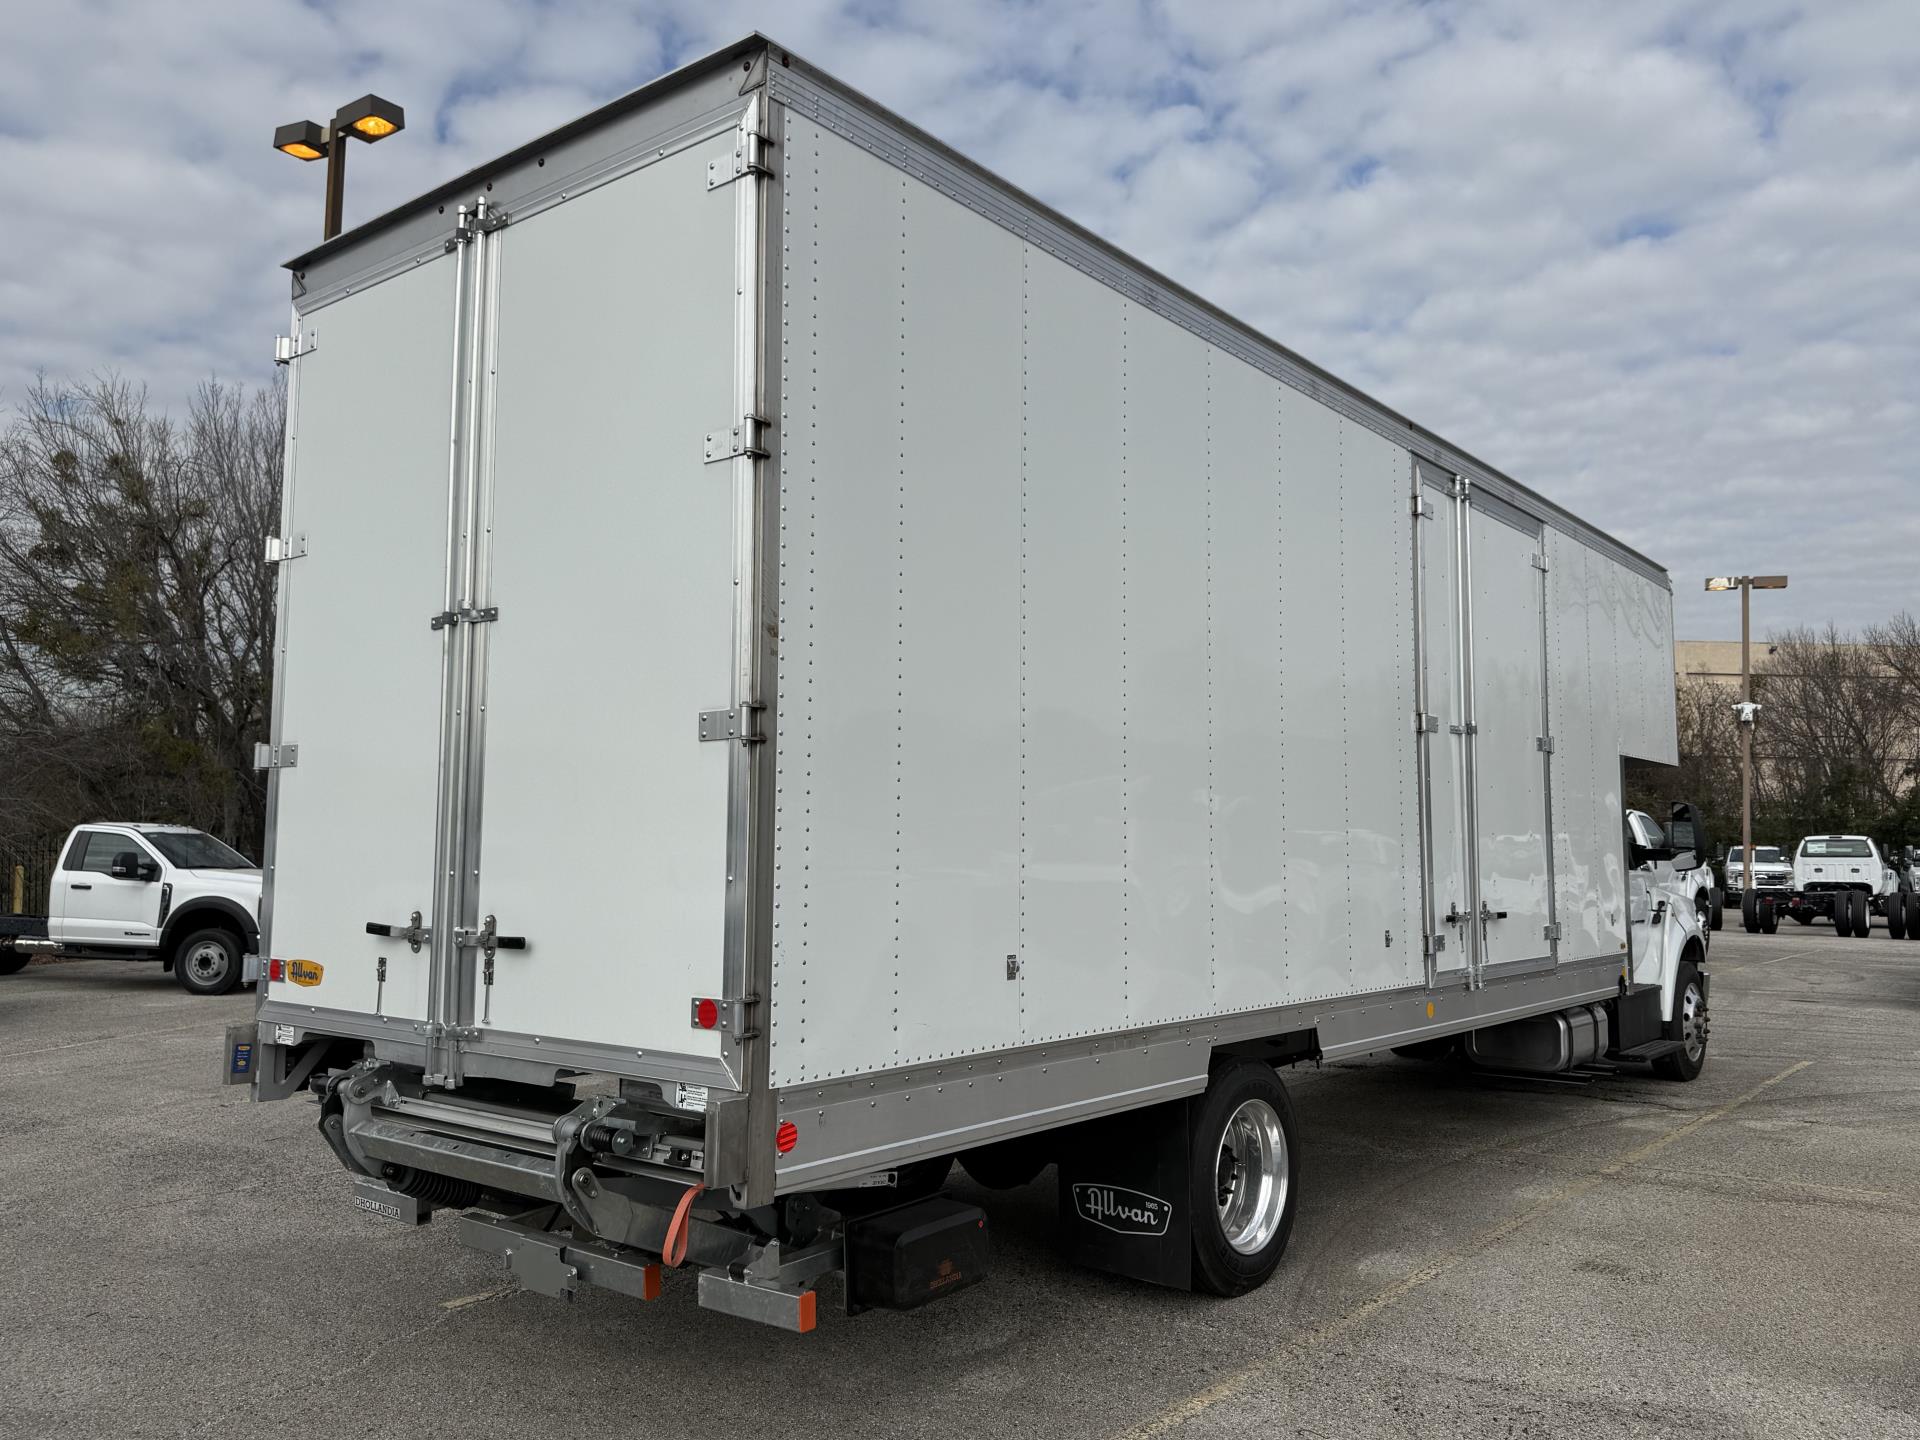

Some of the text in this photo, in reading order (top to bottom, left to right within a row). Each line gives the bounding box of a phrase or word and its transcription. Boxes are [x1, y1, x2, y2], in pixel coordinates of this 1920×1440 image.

[290, 961, 318, 981] Allvan
[355, 1197, 399, 1217] DHOLLANDIA
[1086, 1188, 1158, 1225] Allvan
